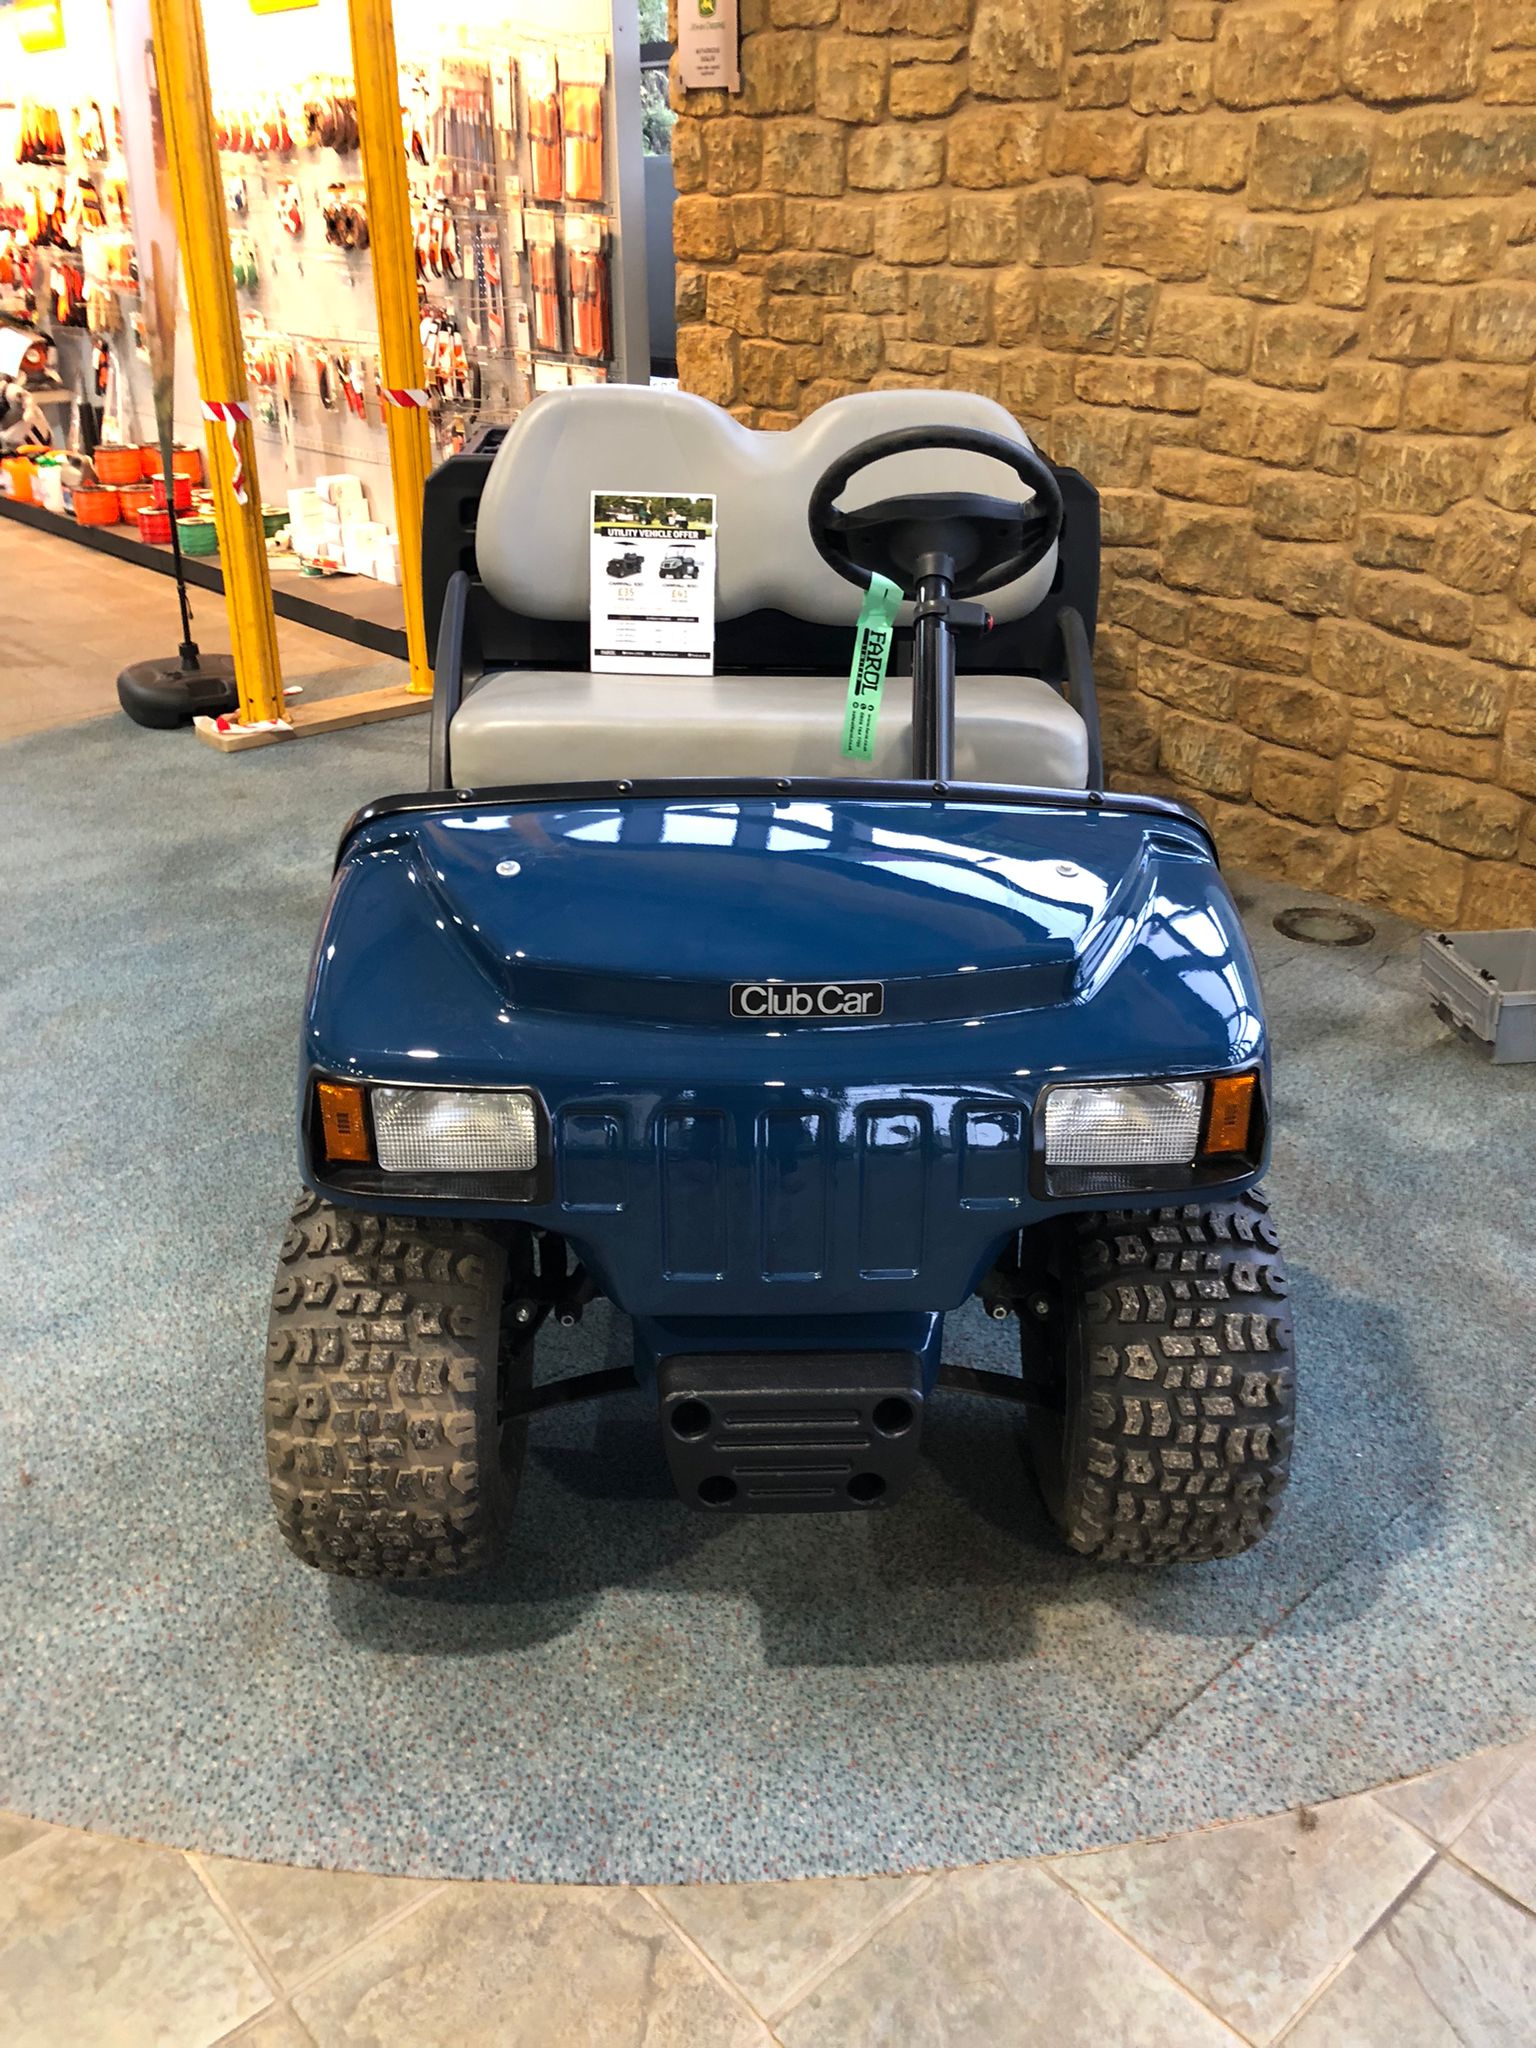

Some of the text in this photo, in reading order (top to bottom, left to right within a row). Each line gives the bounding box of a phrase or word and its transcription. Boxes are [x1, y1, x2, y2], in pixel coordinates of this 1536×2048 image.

[607, 528, 699, 539] UTILITY VEHICLE OFFER
[861, 630, 886, 696] FAROL
[740, 985, 873, 1015] Club Car
